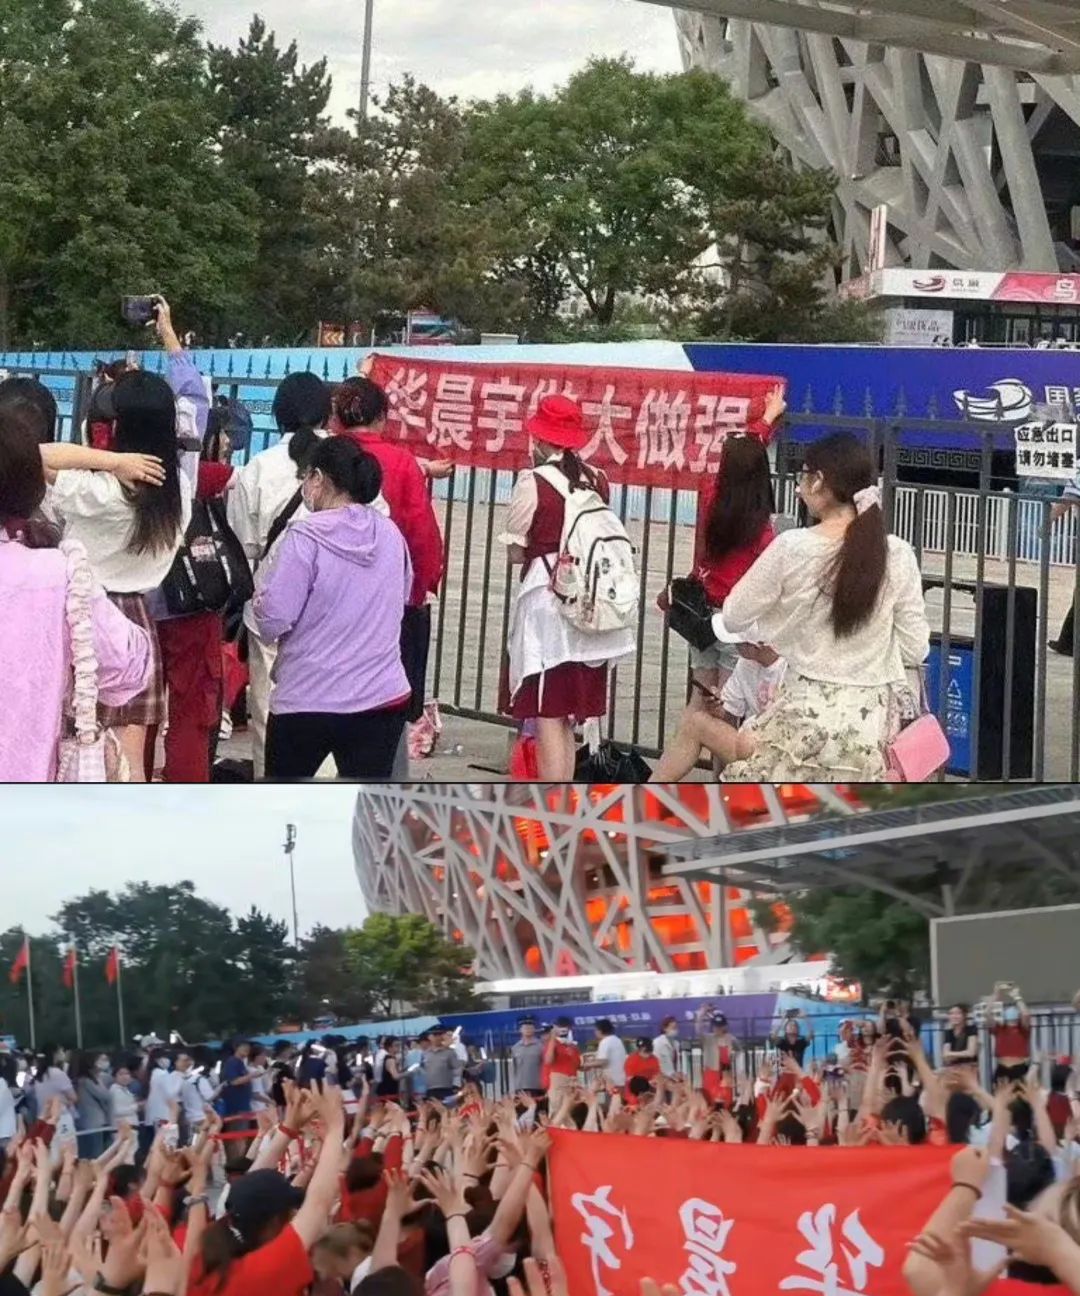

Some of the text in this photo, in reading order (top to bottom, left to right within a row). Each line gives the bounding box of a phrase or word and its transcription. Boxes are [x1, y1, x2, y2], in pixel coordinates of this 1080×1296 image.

[1017, 426, 1073, 443] 应急出口
[1018, 450, 1074, 468] 请勿堵塞
